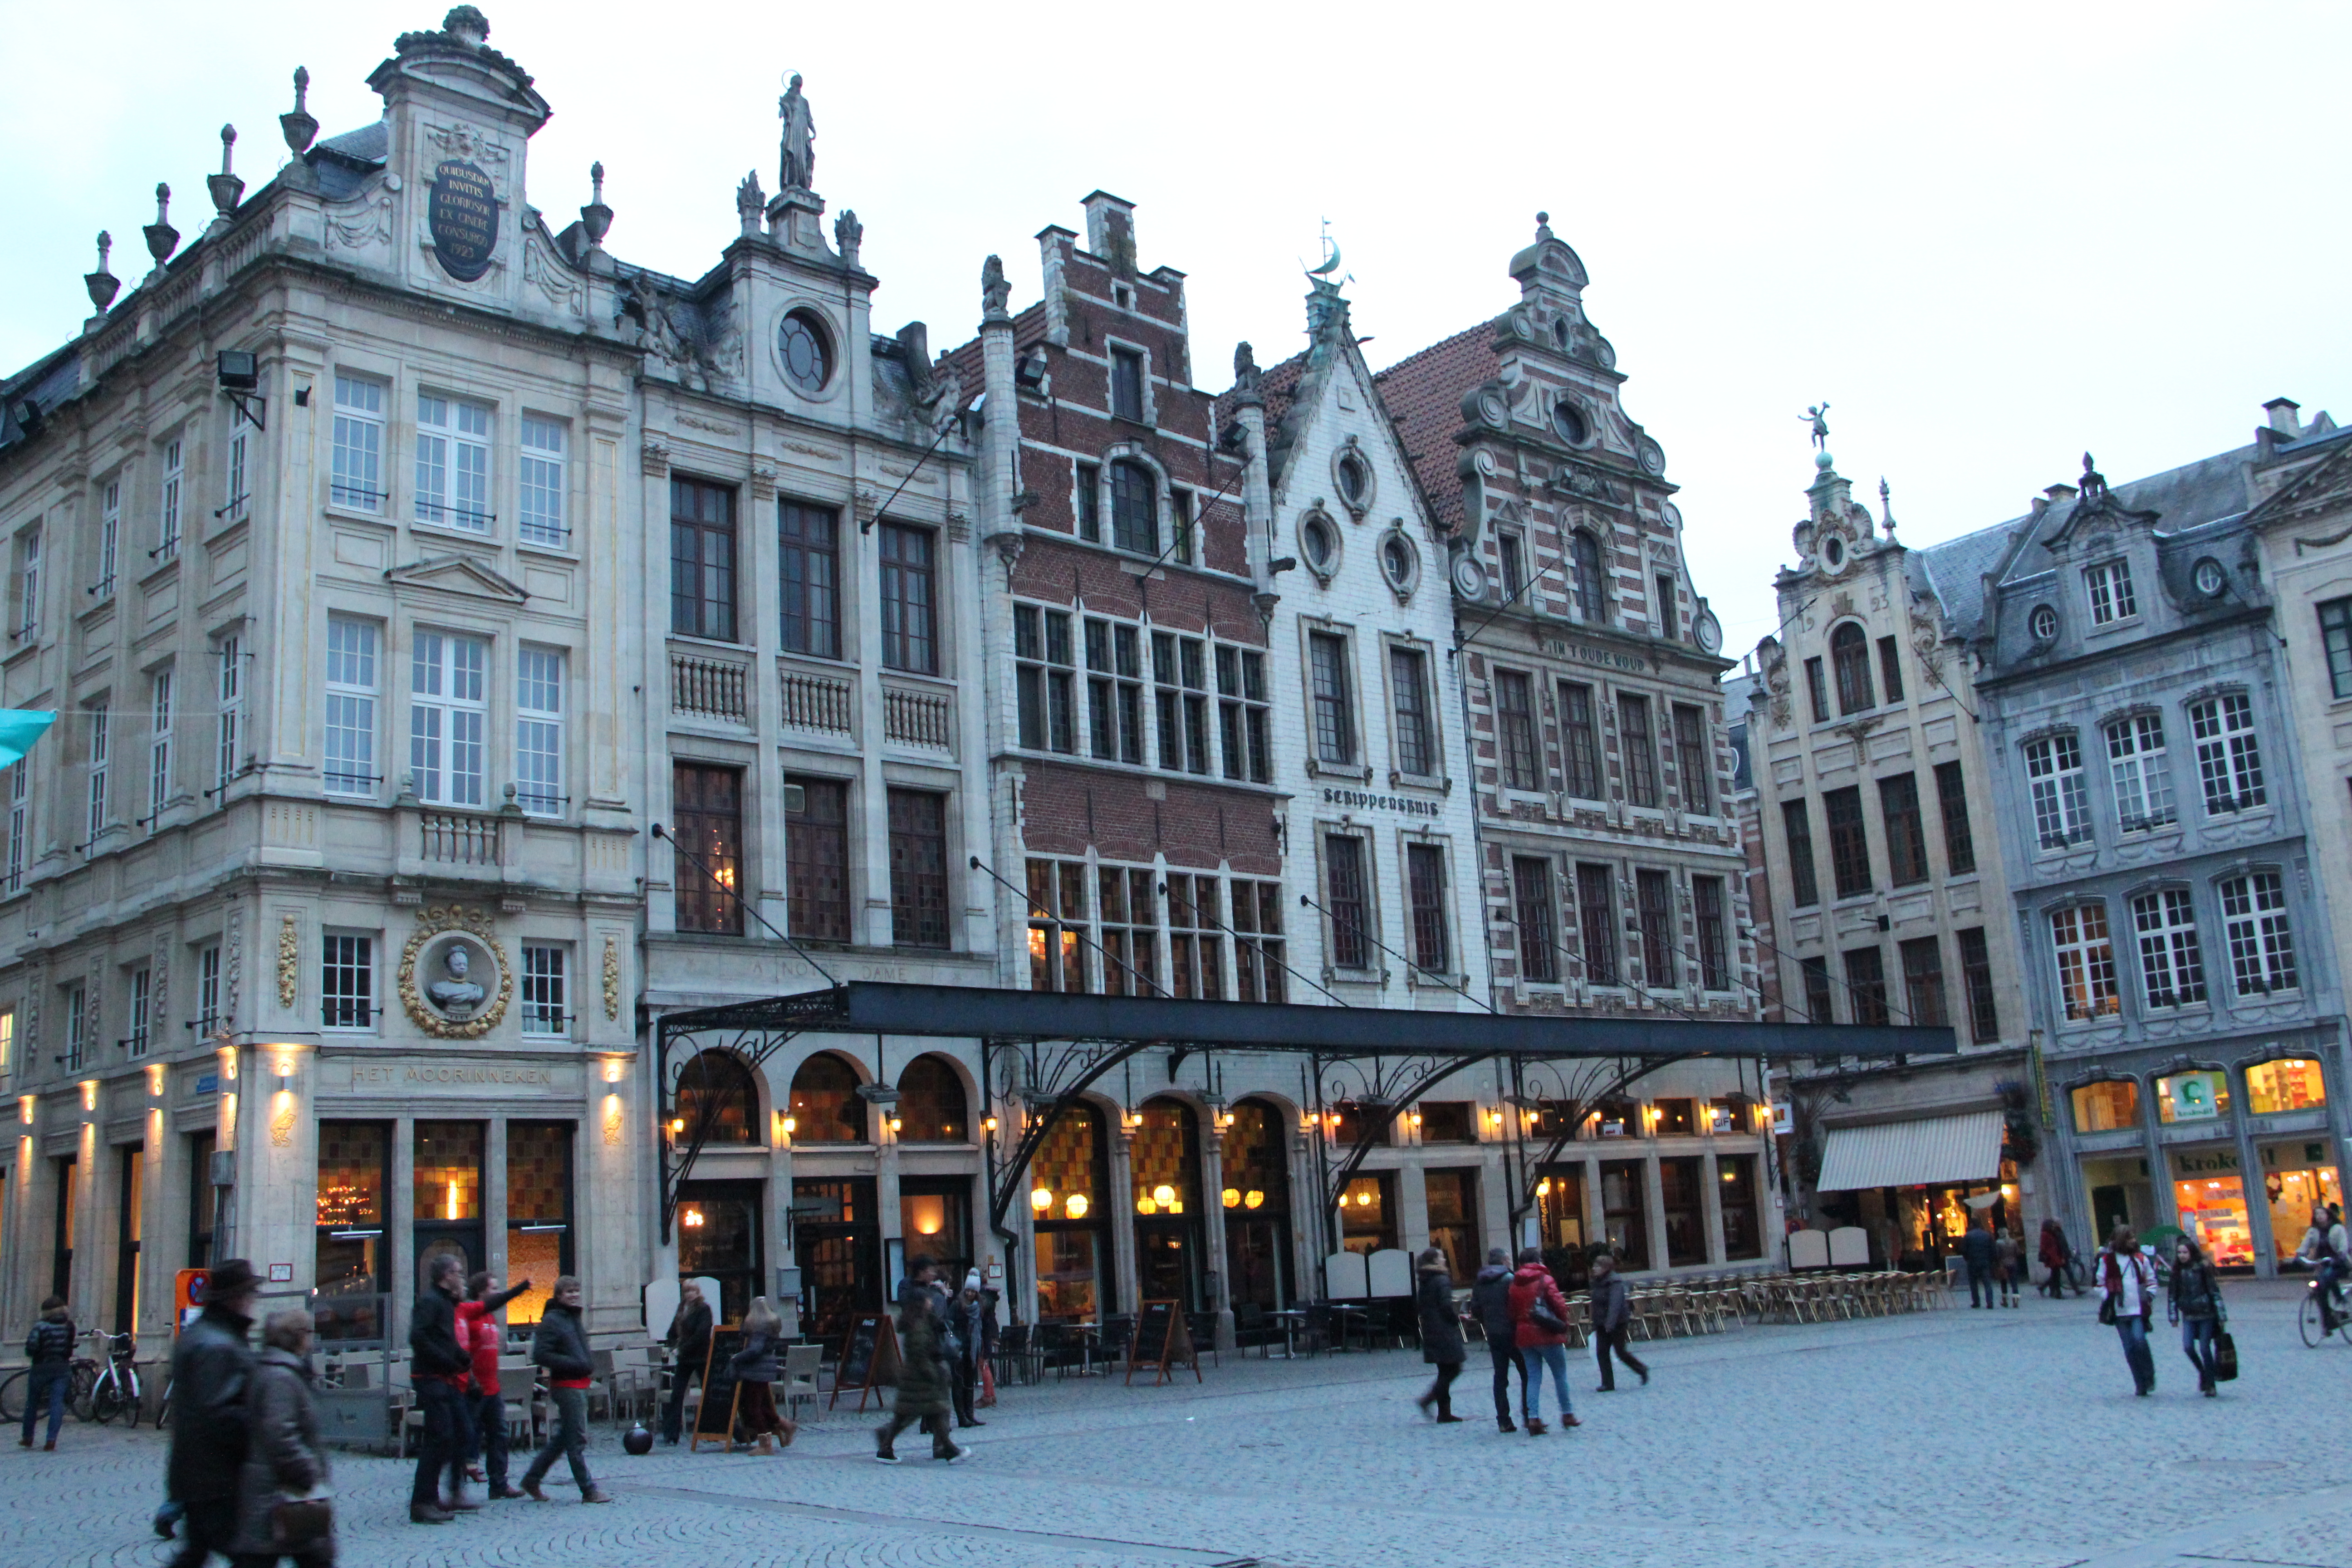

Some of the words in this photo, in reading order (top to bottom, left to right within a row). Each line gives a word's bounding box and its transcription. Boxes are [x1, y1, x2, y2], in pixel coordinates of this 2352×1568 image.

[439, 166, 490, 188] QUIBUSDAM
[449, 180, 483, 198] INVITIS
[440, 208, 452, 220] EX
[458, 212, 488, 231] CINERE
[1871, 594, 1889, 612] 23
[1580, 647, 1611, 665] OUDE
[1613, 654, 1645, 671] WOUD
[862, 965, 907, 981] DAME
[353, 1067, 394, 1081] HET
[404, 1066, 551, 1083] MOORINNEKEN
